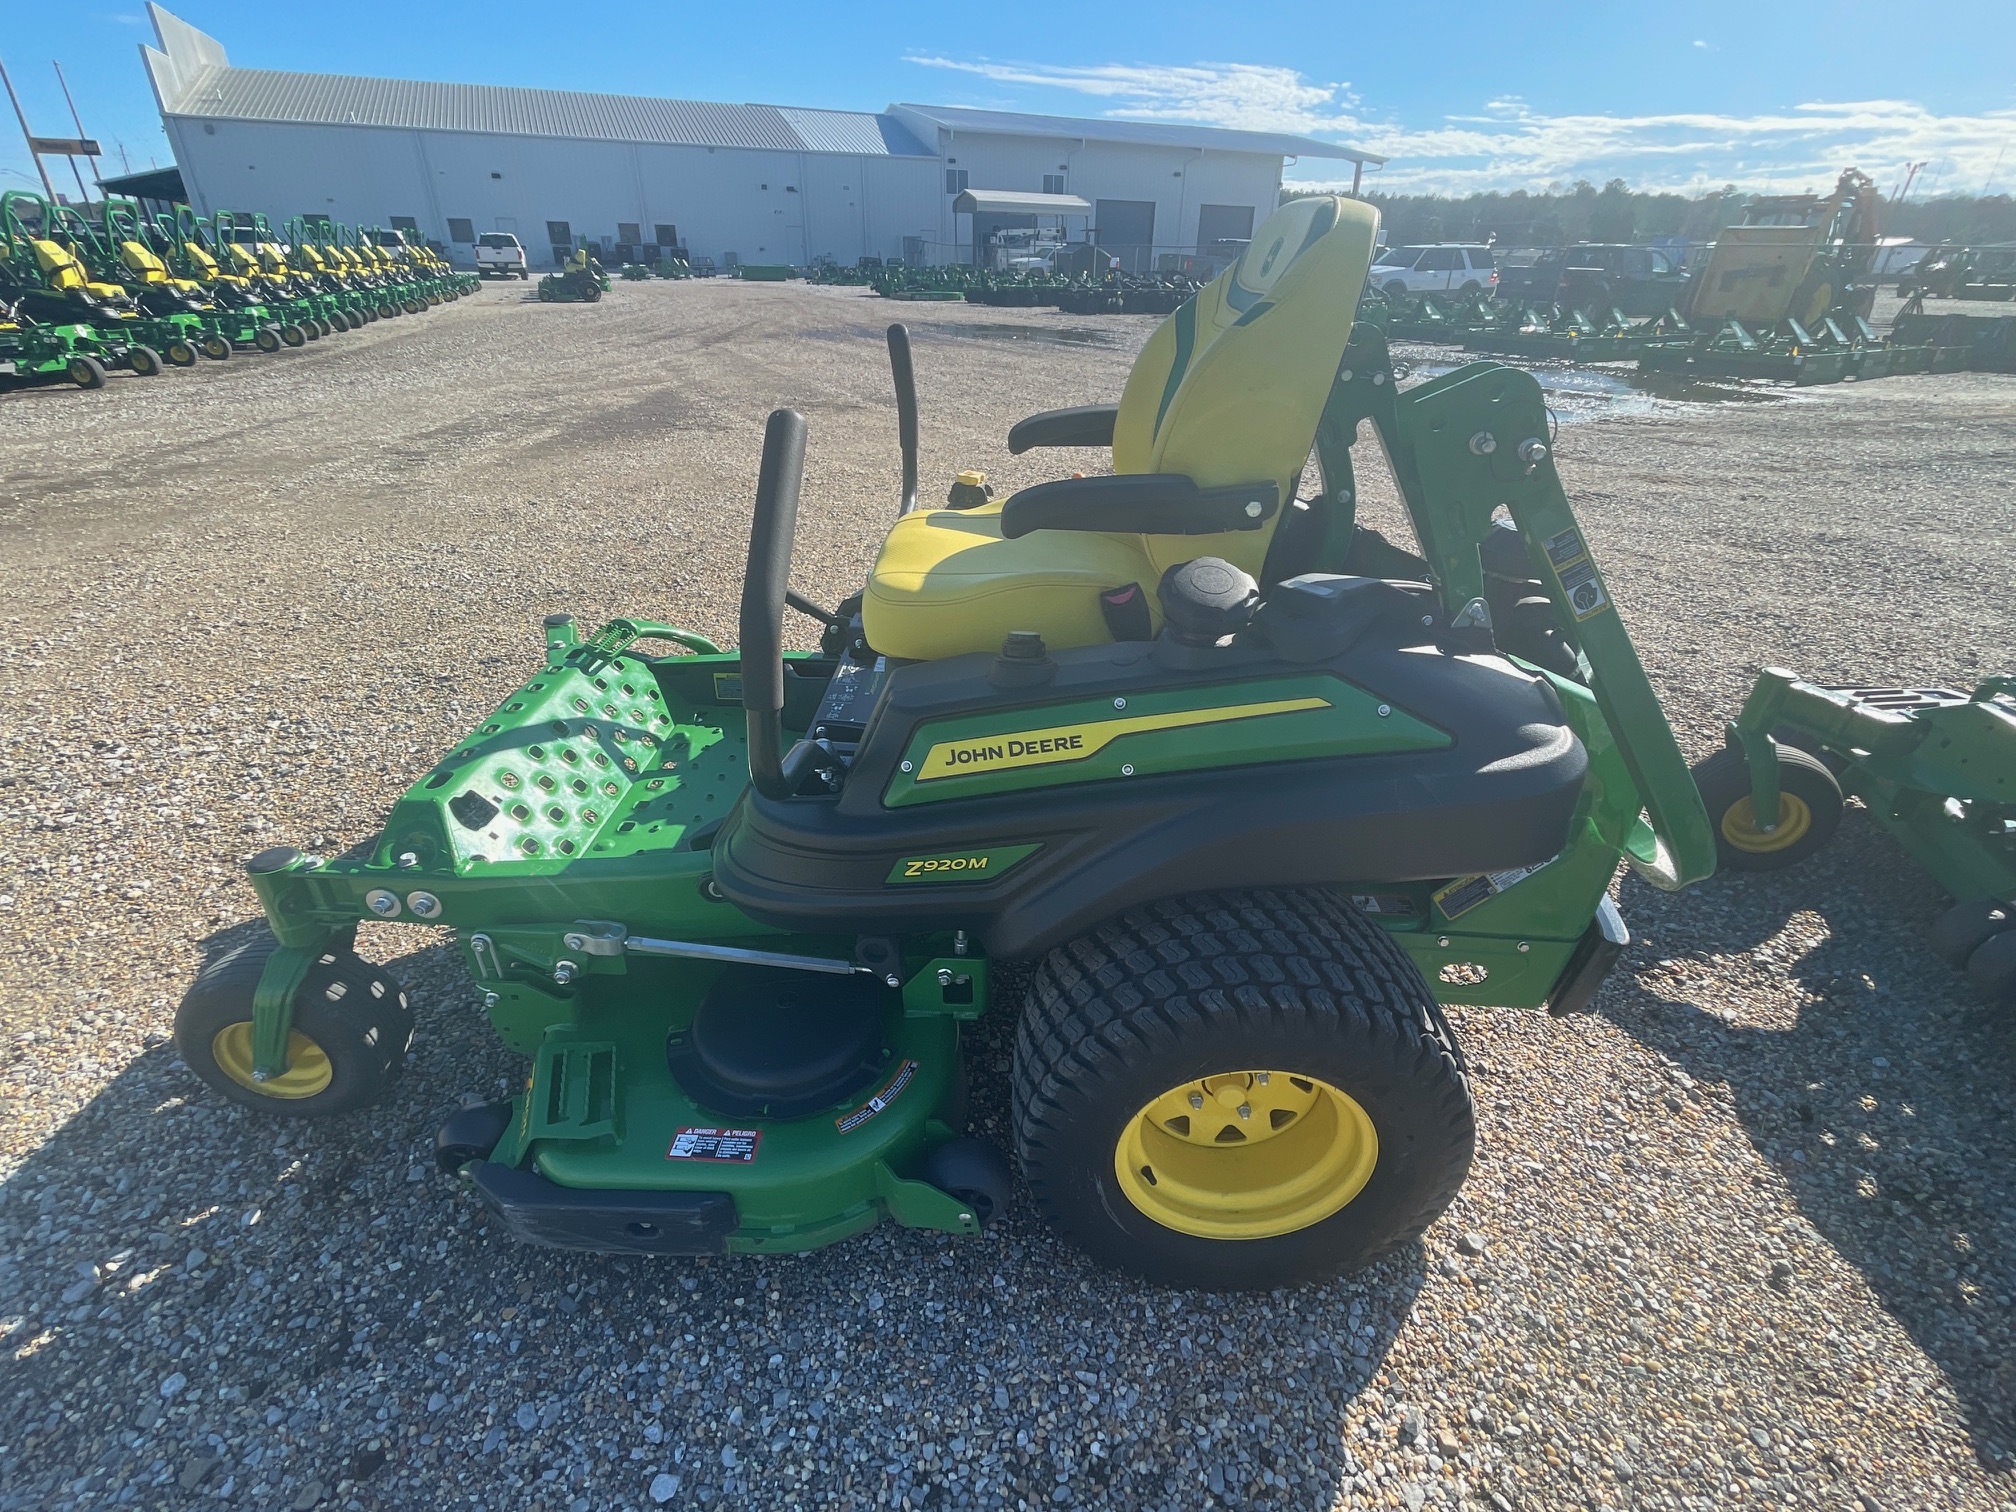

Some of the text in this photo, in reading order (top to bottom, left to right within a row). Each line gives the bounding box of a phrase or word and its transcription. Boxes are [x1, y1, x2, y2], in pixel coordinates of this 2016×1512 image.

[945, 735, 1083, 766] JOHN DEERE
[904, 857, 988, 876] Z920M
